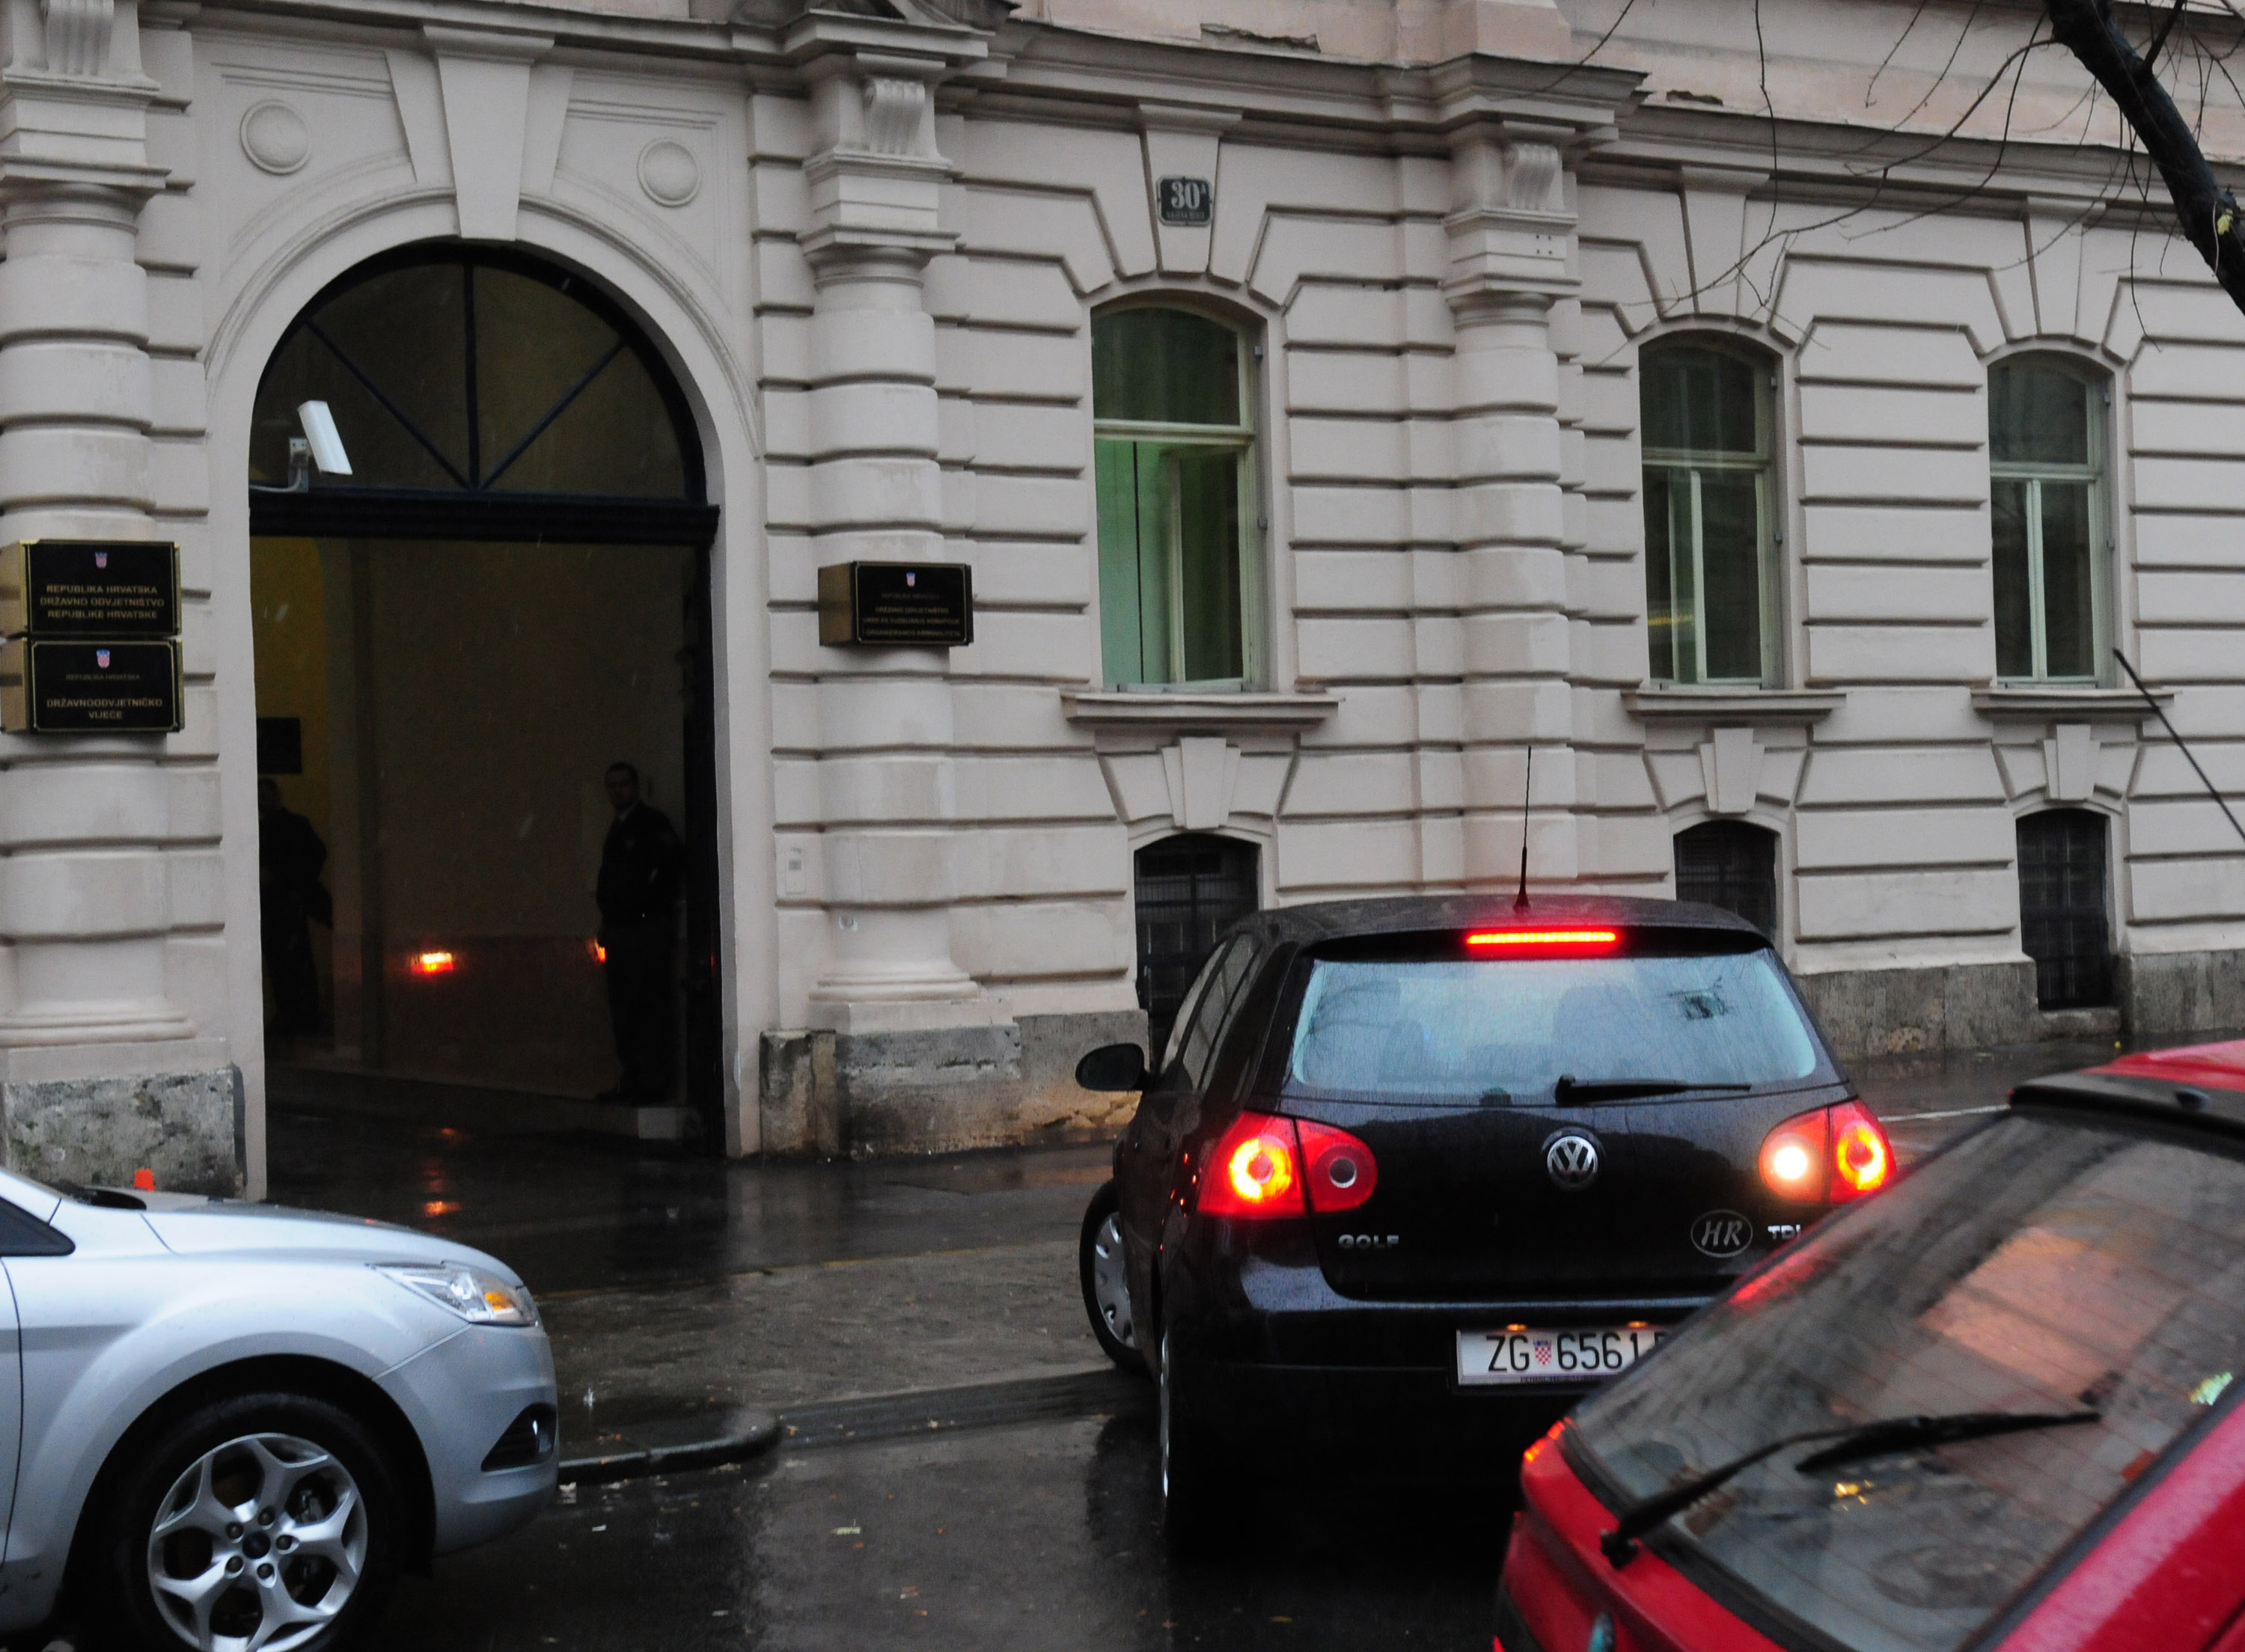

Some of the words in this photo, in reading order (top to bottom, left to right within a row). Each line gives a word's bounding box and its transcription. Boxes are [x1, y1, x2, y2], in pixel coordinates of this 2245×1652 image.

[1171, 181, 1200, 209] 30
[46, 584, 103, 593] REPUBLIKA
[106, 585, 157, 594] HRVATSKA
[40, 596, 88, 606] DRŽAVNO
[91, 597, 165, 607] ODVJETNIŠTVO
[47, 610, 104, 619] REPUBLIKE
[107, 611, 157, 619] HRVATSKE
[1701, 1220, 1743, 1247] HR
[1338, 1234, 1399, 1249] GOLF
[1485, 1335, 1530, 1372] ZG
[1557, 1331, 1667, 1371] 6561
